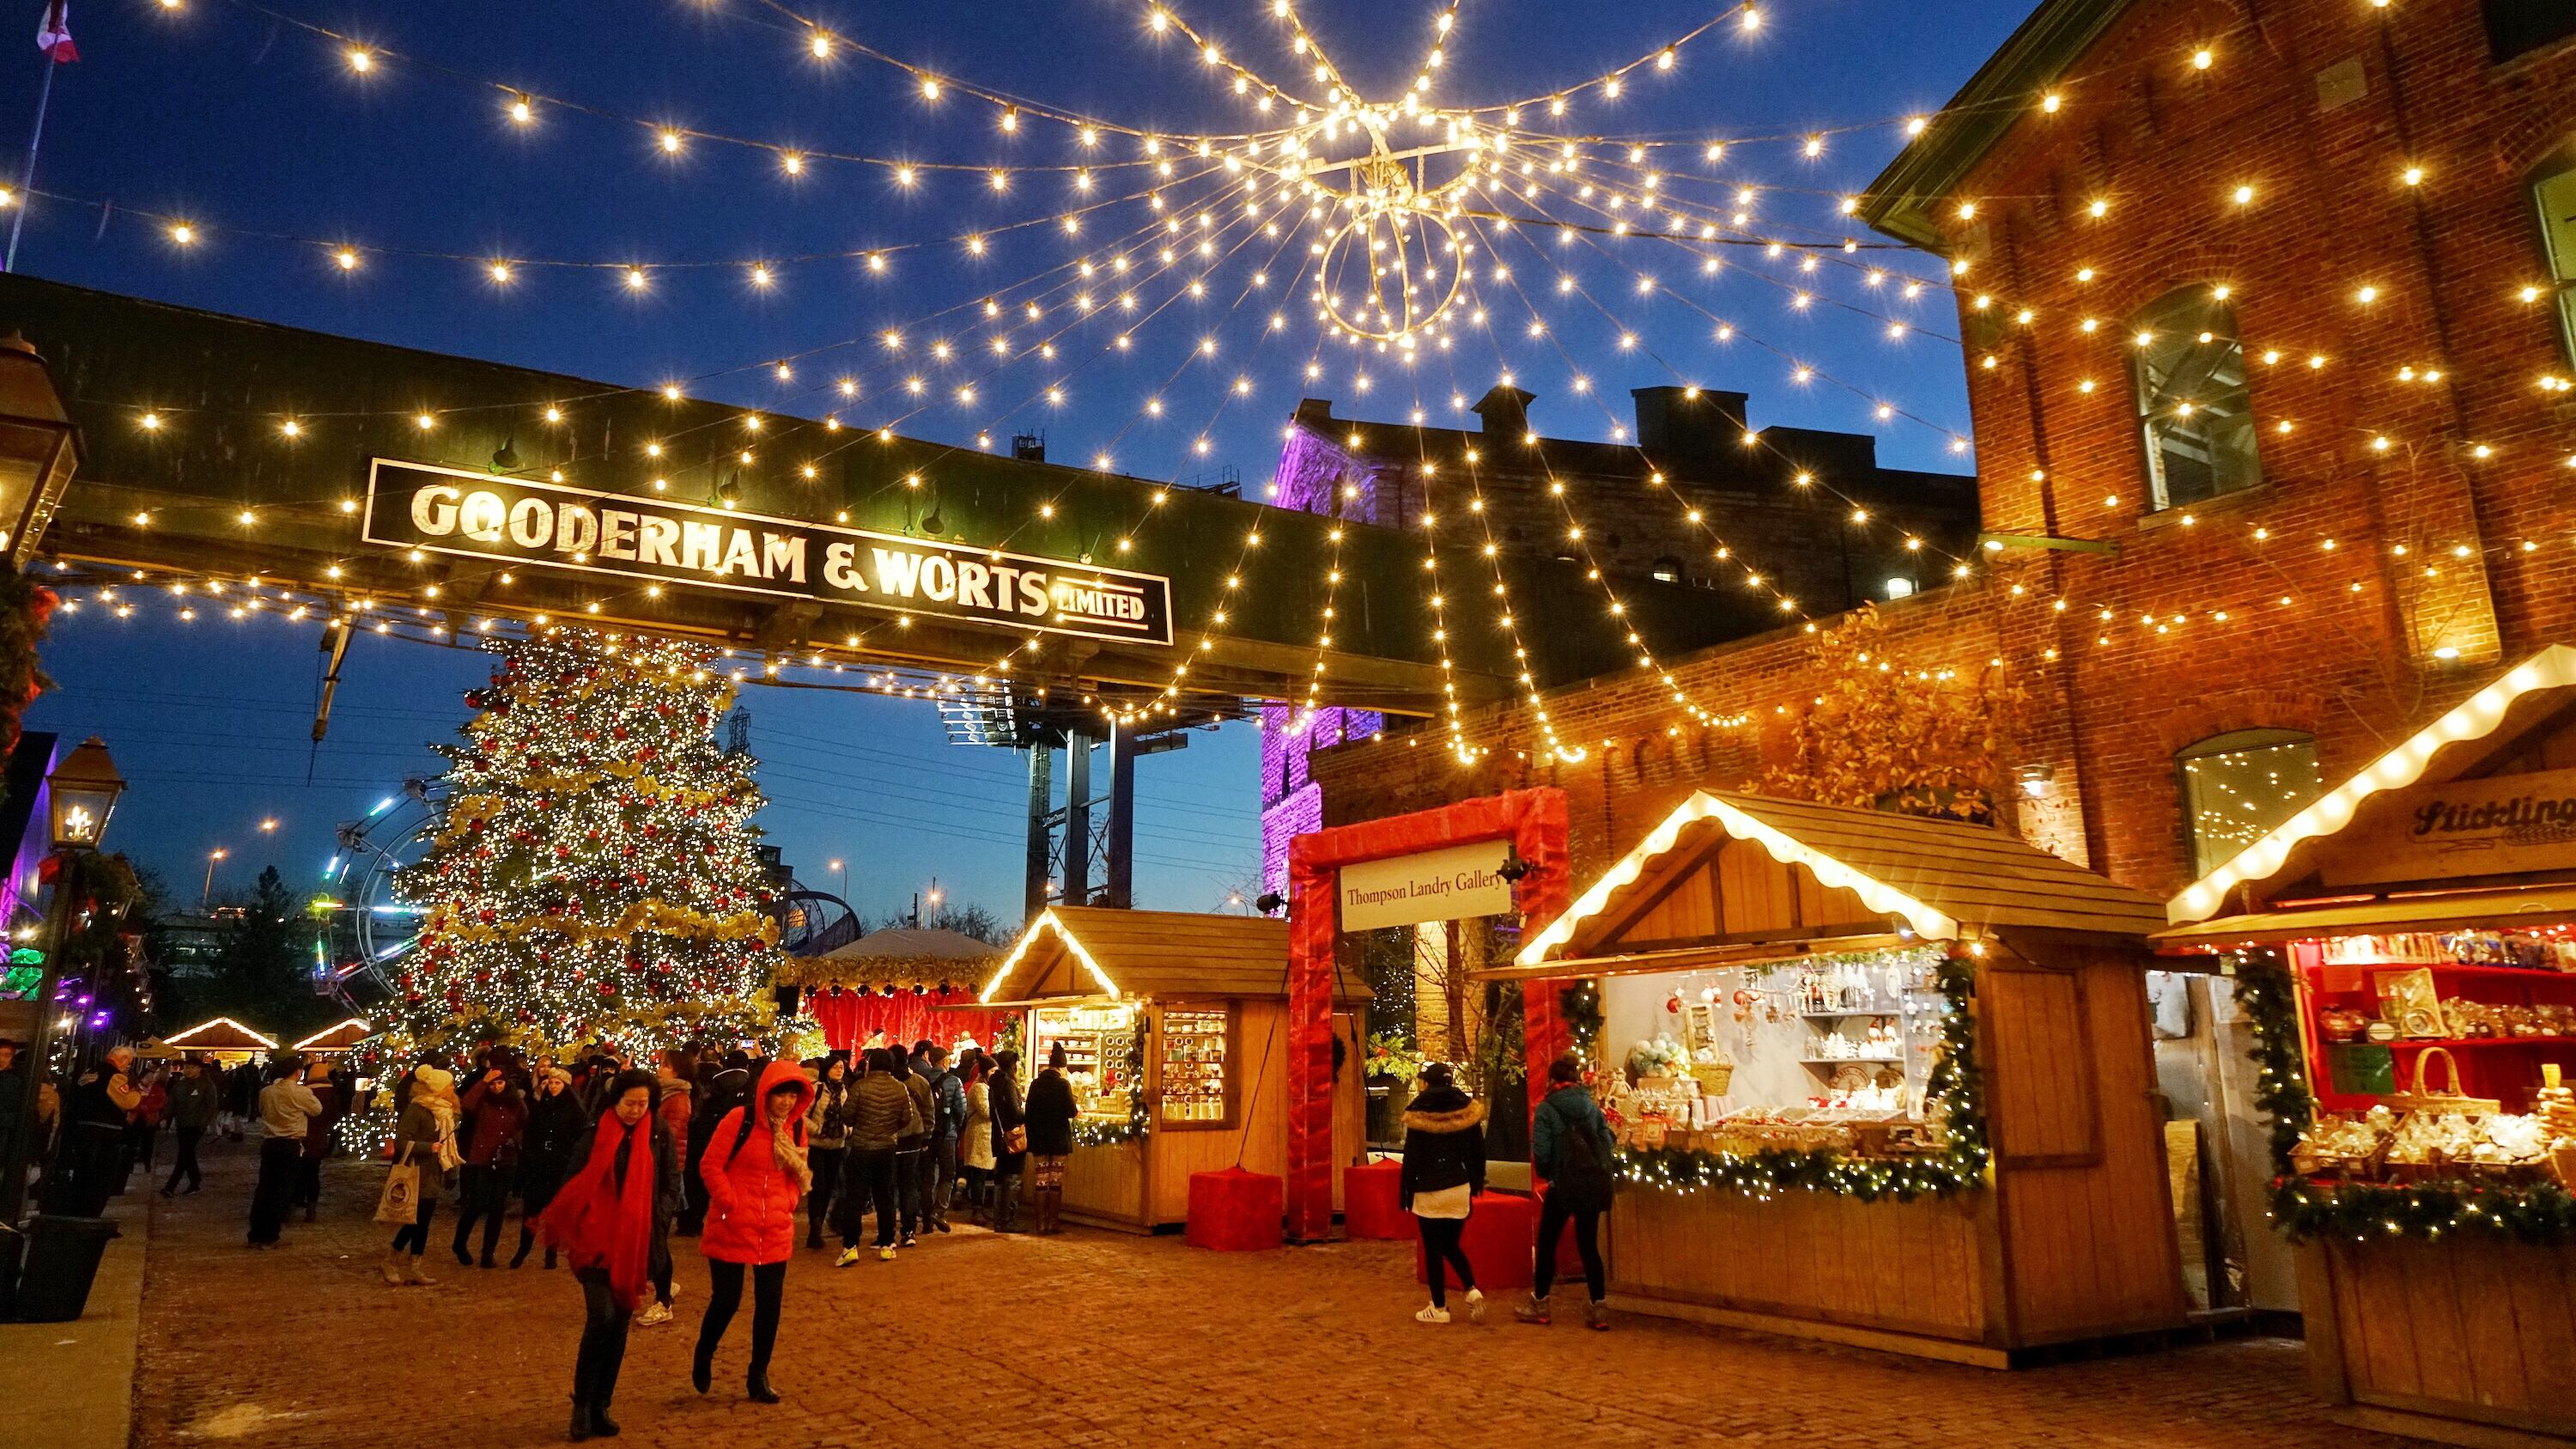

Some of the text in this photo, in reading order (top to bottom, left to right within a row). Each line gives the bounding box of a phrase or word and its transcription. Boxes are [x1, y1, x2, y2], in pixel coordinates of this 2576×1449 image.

[410, 484, 1145, 621] GOODERHAM & WORTS LIMITED
[1347, 869, 1501, 905] Thompson Landry Gallery
